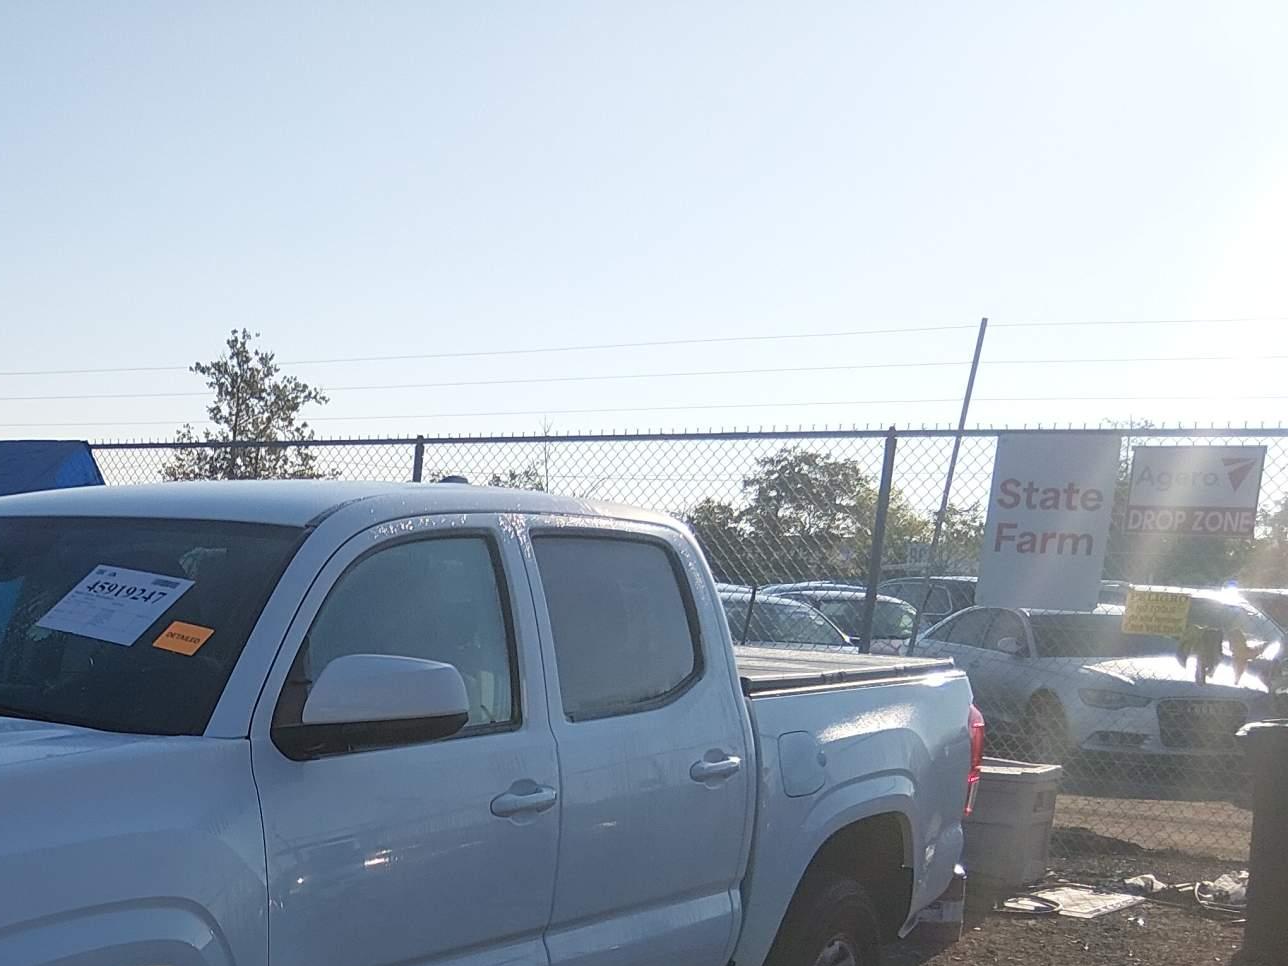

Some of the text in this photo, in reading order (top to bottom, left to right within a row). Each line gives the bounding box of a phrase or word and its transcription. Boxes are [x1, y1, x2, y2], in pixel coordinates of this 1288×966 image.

[1136, 466, 1218, 492] Agero
[997, 478, 1103, 511] State
[1128, 510, 1253, 532] DROP ZONE
[994, 522, 1094, 556] Farm
[86, 580, 168, 604] 45919247
